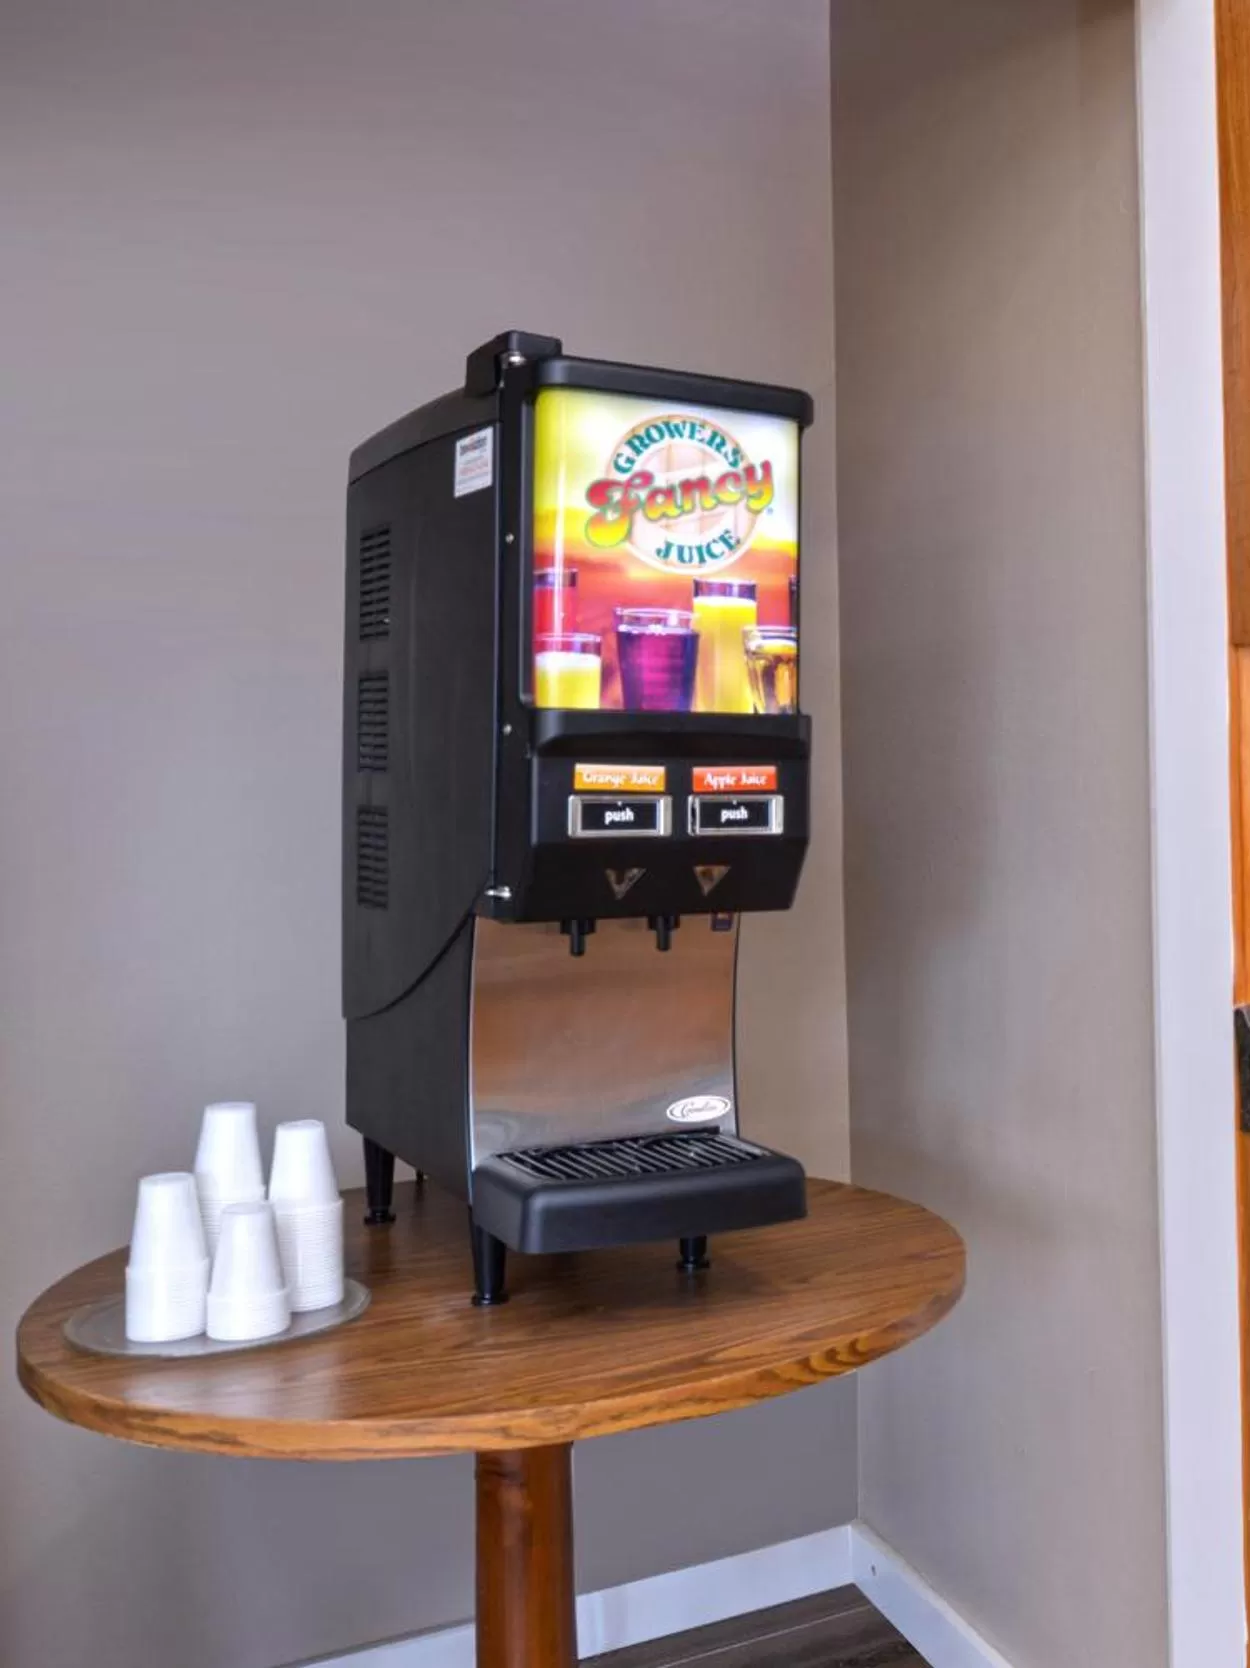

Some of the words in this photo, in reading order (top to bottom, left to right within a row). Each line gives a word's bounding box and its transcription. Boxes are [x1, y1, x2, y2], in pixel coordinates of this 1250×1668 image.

[613, 420, 744, 475] GROWERS
[585, 460, 774, 548] Fancy
[656, 529, 740, 564] JUICE
[703, 772, 737, 791] Apple
[740, 771, 768, 786] Juice
[604, 808, 635, 826] push
[720, 805, 749, 824] push
